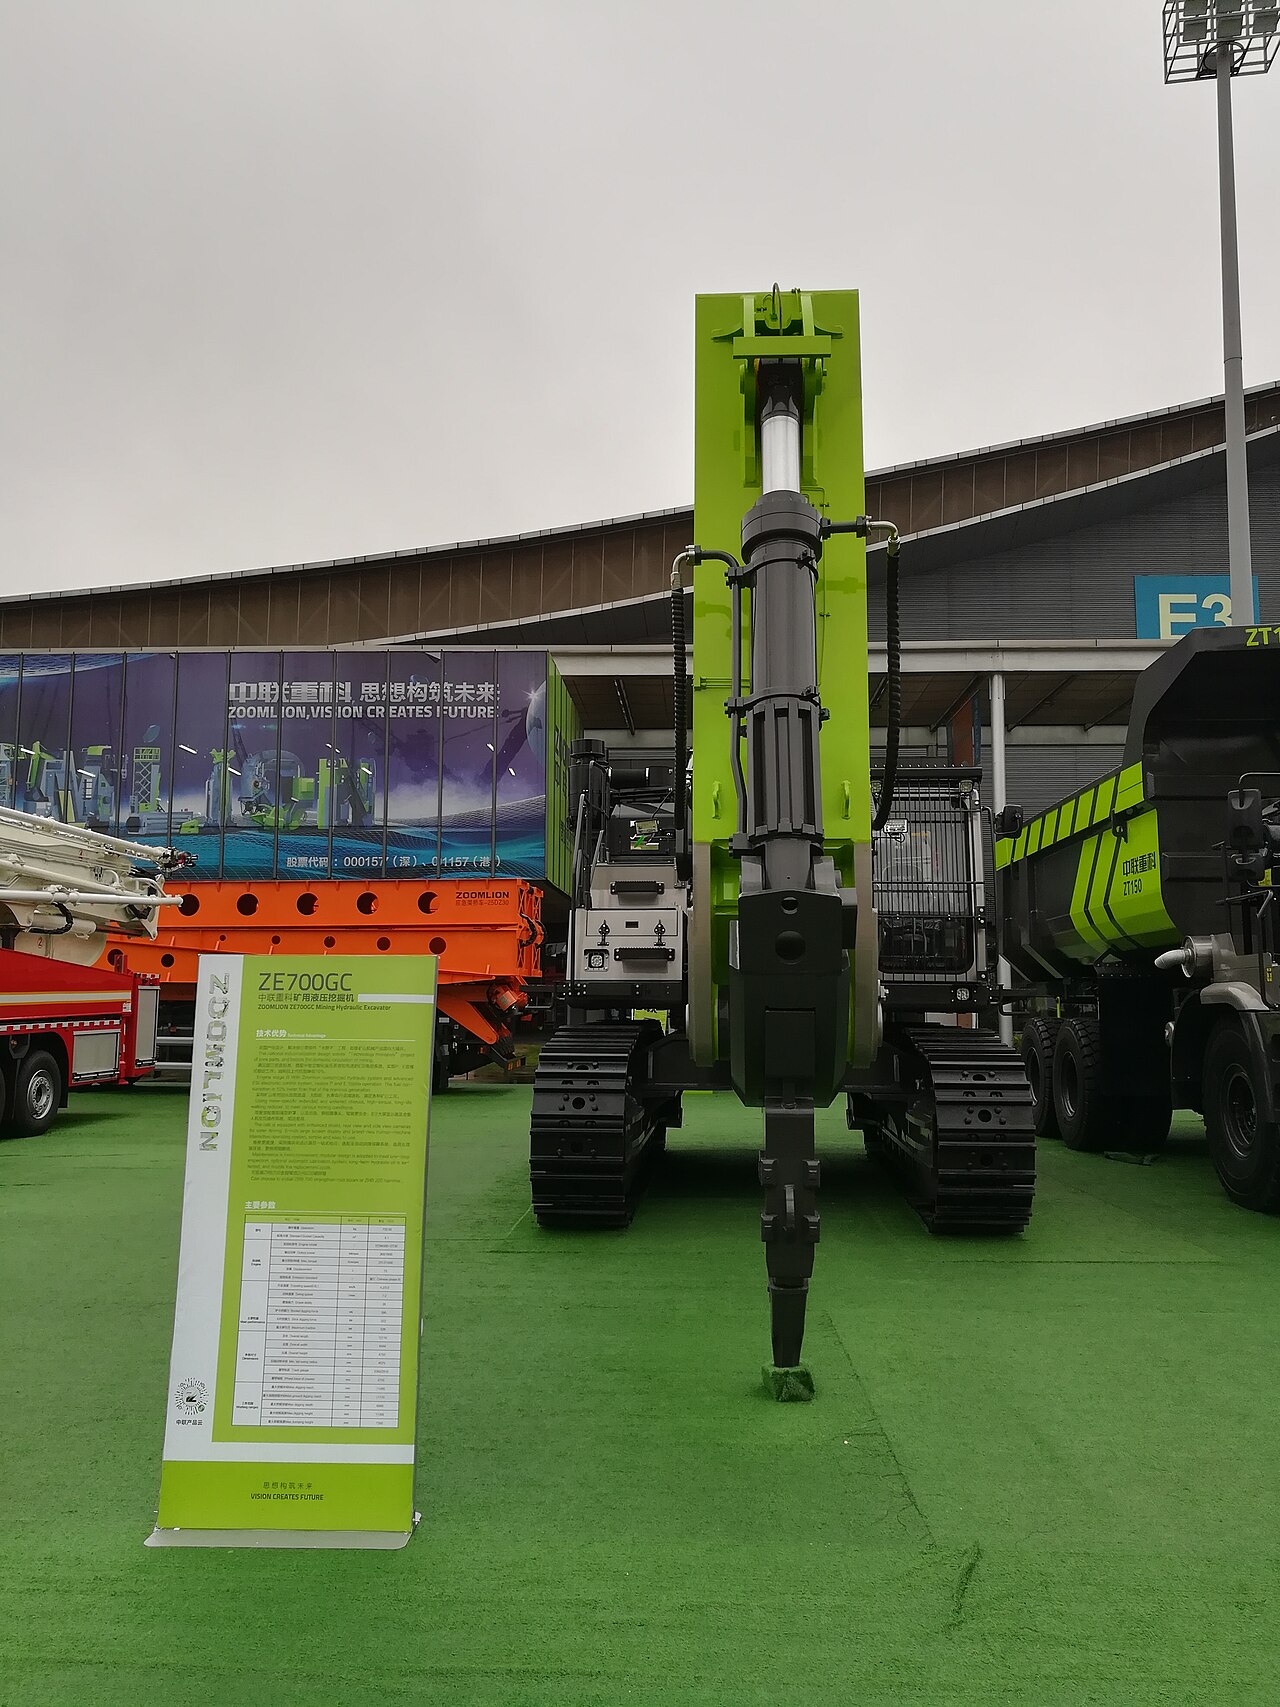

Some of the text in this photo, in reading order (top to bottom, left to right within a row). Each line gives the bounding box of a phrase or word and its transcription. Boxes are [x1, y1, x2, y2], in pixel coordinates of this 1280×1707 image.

[1158, 593, 1232, 640] E3
[360, 682, 500, 702] 思想构筑未来
[366, 705, 433, 719] CREATES
[436, 705, 500, 719] FUTURE
[1122, 851, 1156, 876] 中联重科
[455, 891, 510, 899] ZOOMLION
[1123, 878, 1143, 896] ZT150
[258, 972, 353, 991] ZE700GC
[258, 993, 354, 1002] 中联重科矿用液压挖掘机
[256, 1029, 287, 1038] 技术优势
[300, 1493, 325, 1501] FUTURE
